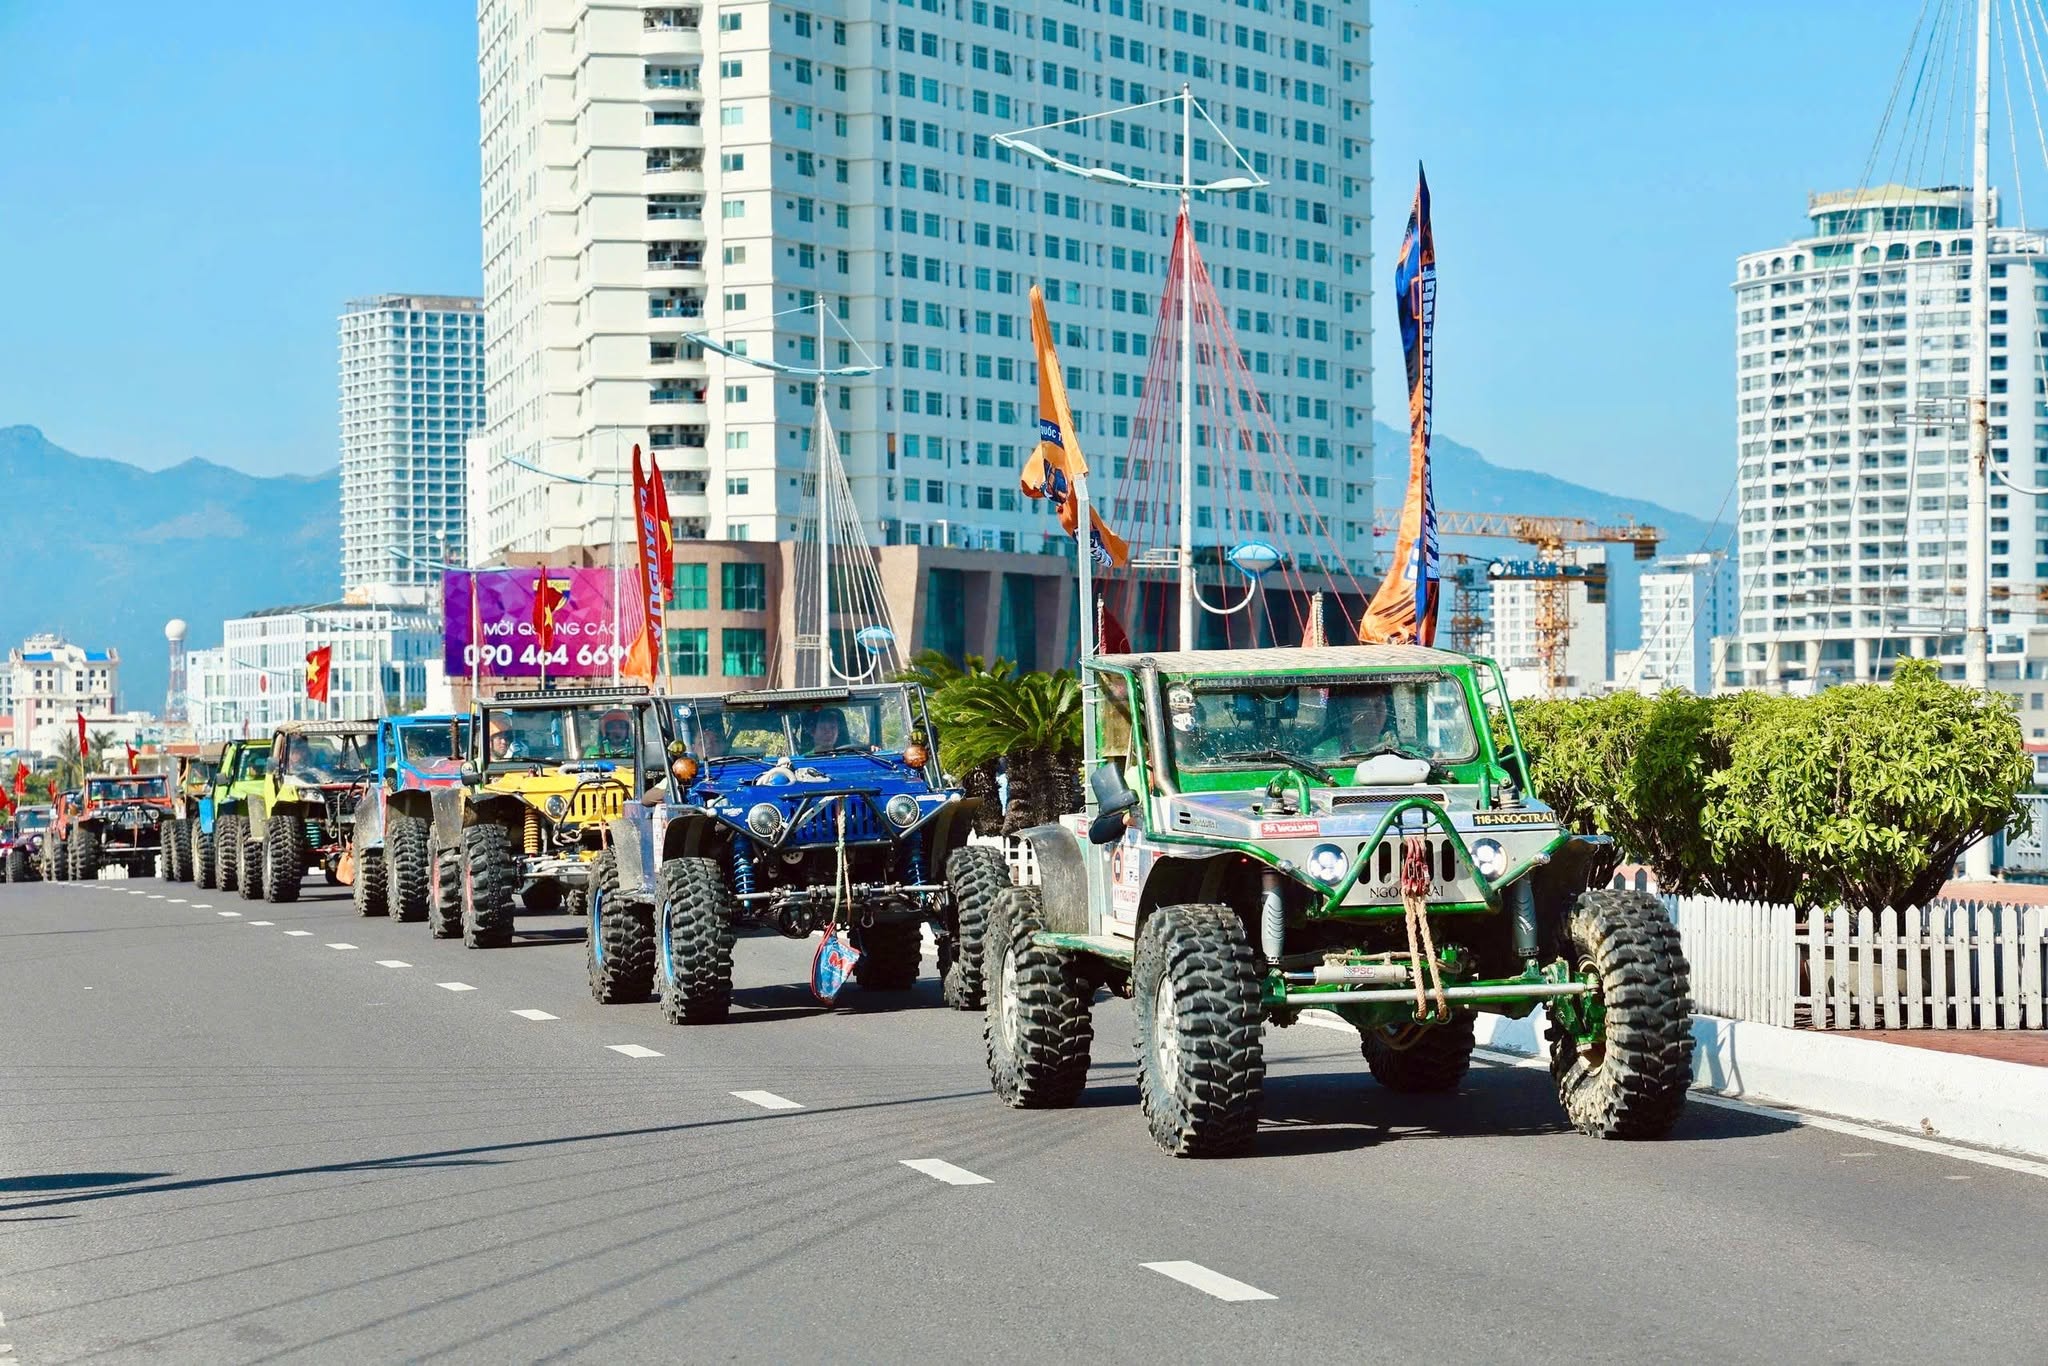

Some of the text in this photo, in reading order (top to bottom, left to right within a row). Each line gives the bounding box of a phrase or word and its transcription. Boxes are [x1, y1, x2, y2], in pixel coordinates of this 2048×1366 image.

[517, 622, 581, 636] QNG
[463, 643, 513, 667] 090
[519, 644, 569, 666] 464
[1352, 966, 1374, 975] PSC
